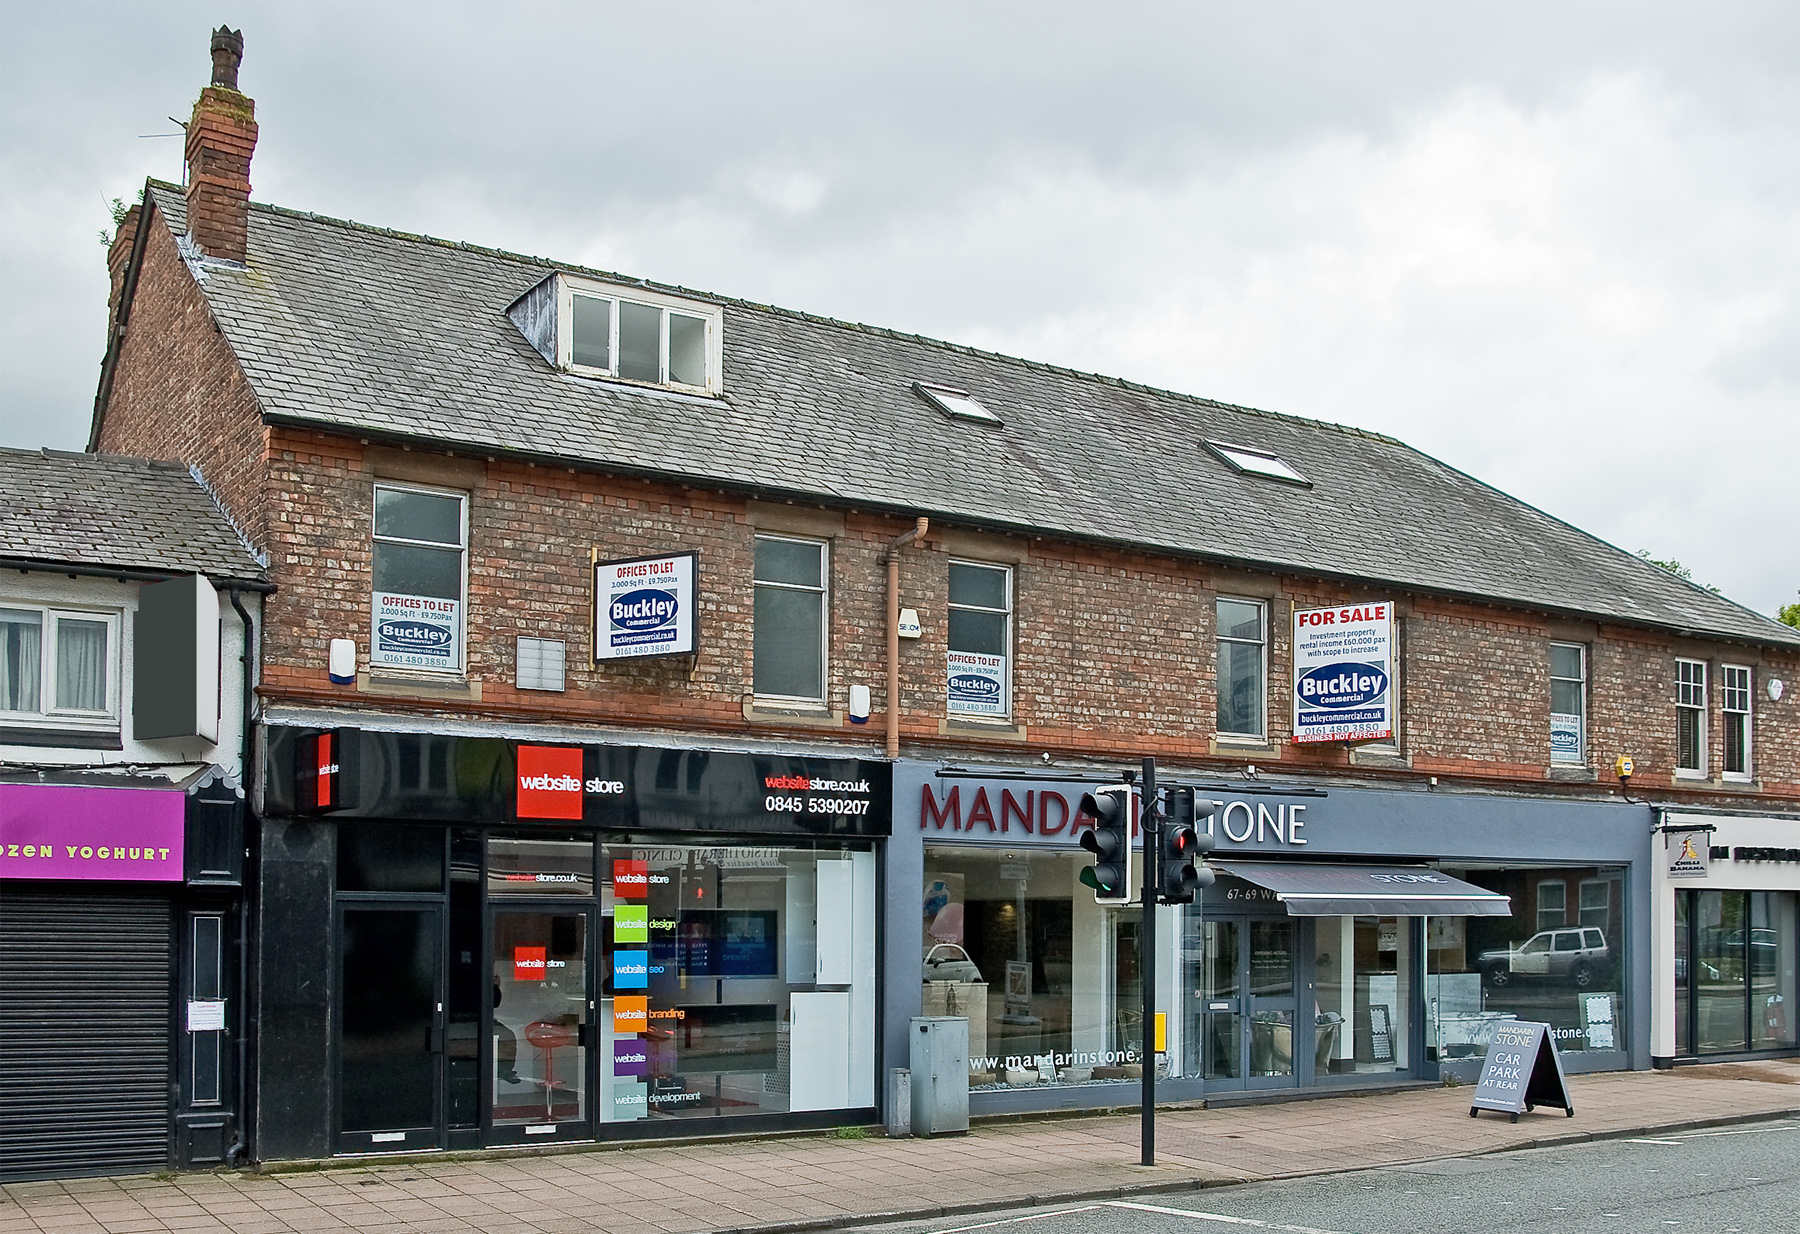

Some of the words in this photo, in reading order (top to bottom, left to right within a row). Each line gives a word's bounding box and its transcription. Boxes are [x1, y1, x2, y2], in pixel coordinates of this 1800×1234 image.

[617, 564, 647, 578] OFFICES
[649, 564, 659, 574] TO
[660, 562, 674, 573] LET
[382, 596, 420, 608] OFFICES
[423, 600, 435, 610] TO
[438, 602, 454, 612] LET
[613, 598, 675, 619] Buckley
[626, 617, 660, 626] Commercial
[1299, 612, 1335, 627] FOR
[1340, 606, 1385, 623] SALE
[382, 625, 448, 642] Buckley
[1310, 632, 1346, 640] Investment
[1347, 628, 1376, 638] property
[616, 647, 631, 655] 0161
[650, 644, 670, 653] 3880
[1300, 641, 1318, 650] rental
[1319, 639, 1342, 648] income
[1322, 648, 1341, 656] scope
[384, 654, 402, 662] 0161
[425, 658, 447, 666] 3880
[948, 654, 976, 664] OFFICES
[978, 657, 987, 665] TO
[989, 658, 1000, 666] LET
[950, 678, 997, 692] Buckley
[1302, 673, 1383, 696] Buckley
[1320, 694, 1364, 704] Commercial
[1301, 710, 1382, 723] buckleycommercial.co.uk
[1305, 727, 1326, 735] 0161
[1329, 725, 1350, 734] 480
[1352, 723, 1379, 732] 3880
[1298, 732, 1332, 743] BUSINESS
[1334, 732, 1350, 740] NOT
[1350, 730, 1387, 739] AFFECTED
[520, 773, 581, 792] website
[585, 777, 624, 794] store
[765, 775, 870, 792] websitestore.co.uk
[766, 796, 802, 812] 0845
[808, 798, 870, 815] 5390207
[920, 783, 1139, 837] MANDAI
[1206, 800, 1308, 844] TONE
[0, 844, 53, 858] ZEN
[66, 846, 170, 860] YOGHURT
[615, 874, 647, 884] website
[649, 874, 669, 884] store
[615, 919, 647, 929] website
[649, 919, 676, 930] design
[516, 959, 544, 968] website
[546, 960, 565, 968] store
[615, 965, 647, 974] website
[615, 1010, 646, 1019] website
[649, 1009, 685, 1019] branding
[1500, 1026, 1535, 1036] MANDARIN
[1495, 1034, 1533, 1048] STONE
[615, 1053, 646, 1063] website
[1495, 1053, 1521, 1066] CAR
[1488, 1066, 1521, 1079] PARK
[1497, 1080, 1518, 1091] REAR
[615, 1094, 646, 1105] website
[649, 1092, 701, 1103] development
